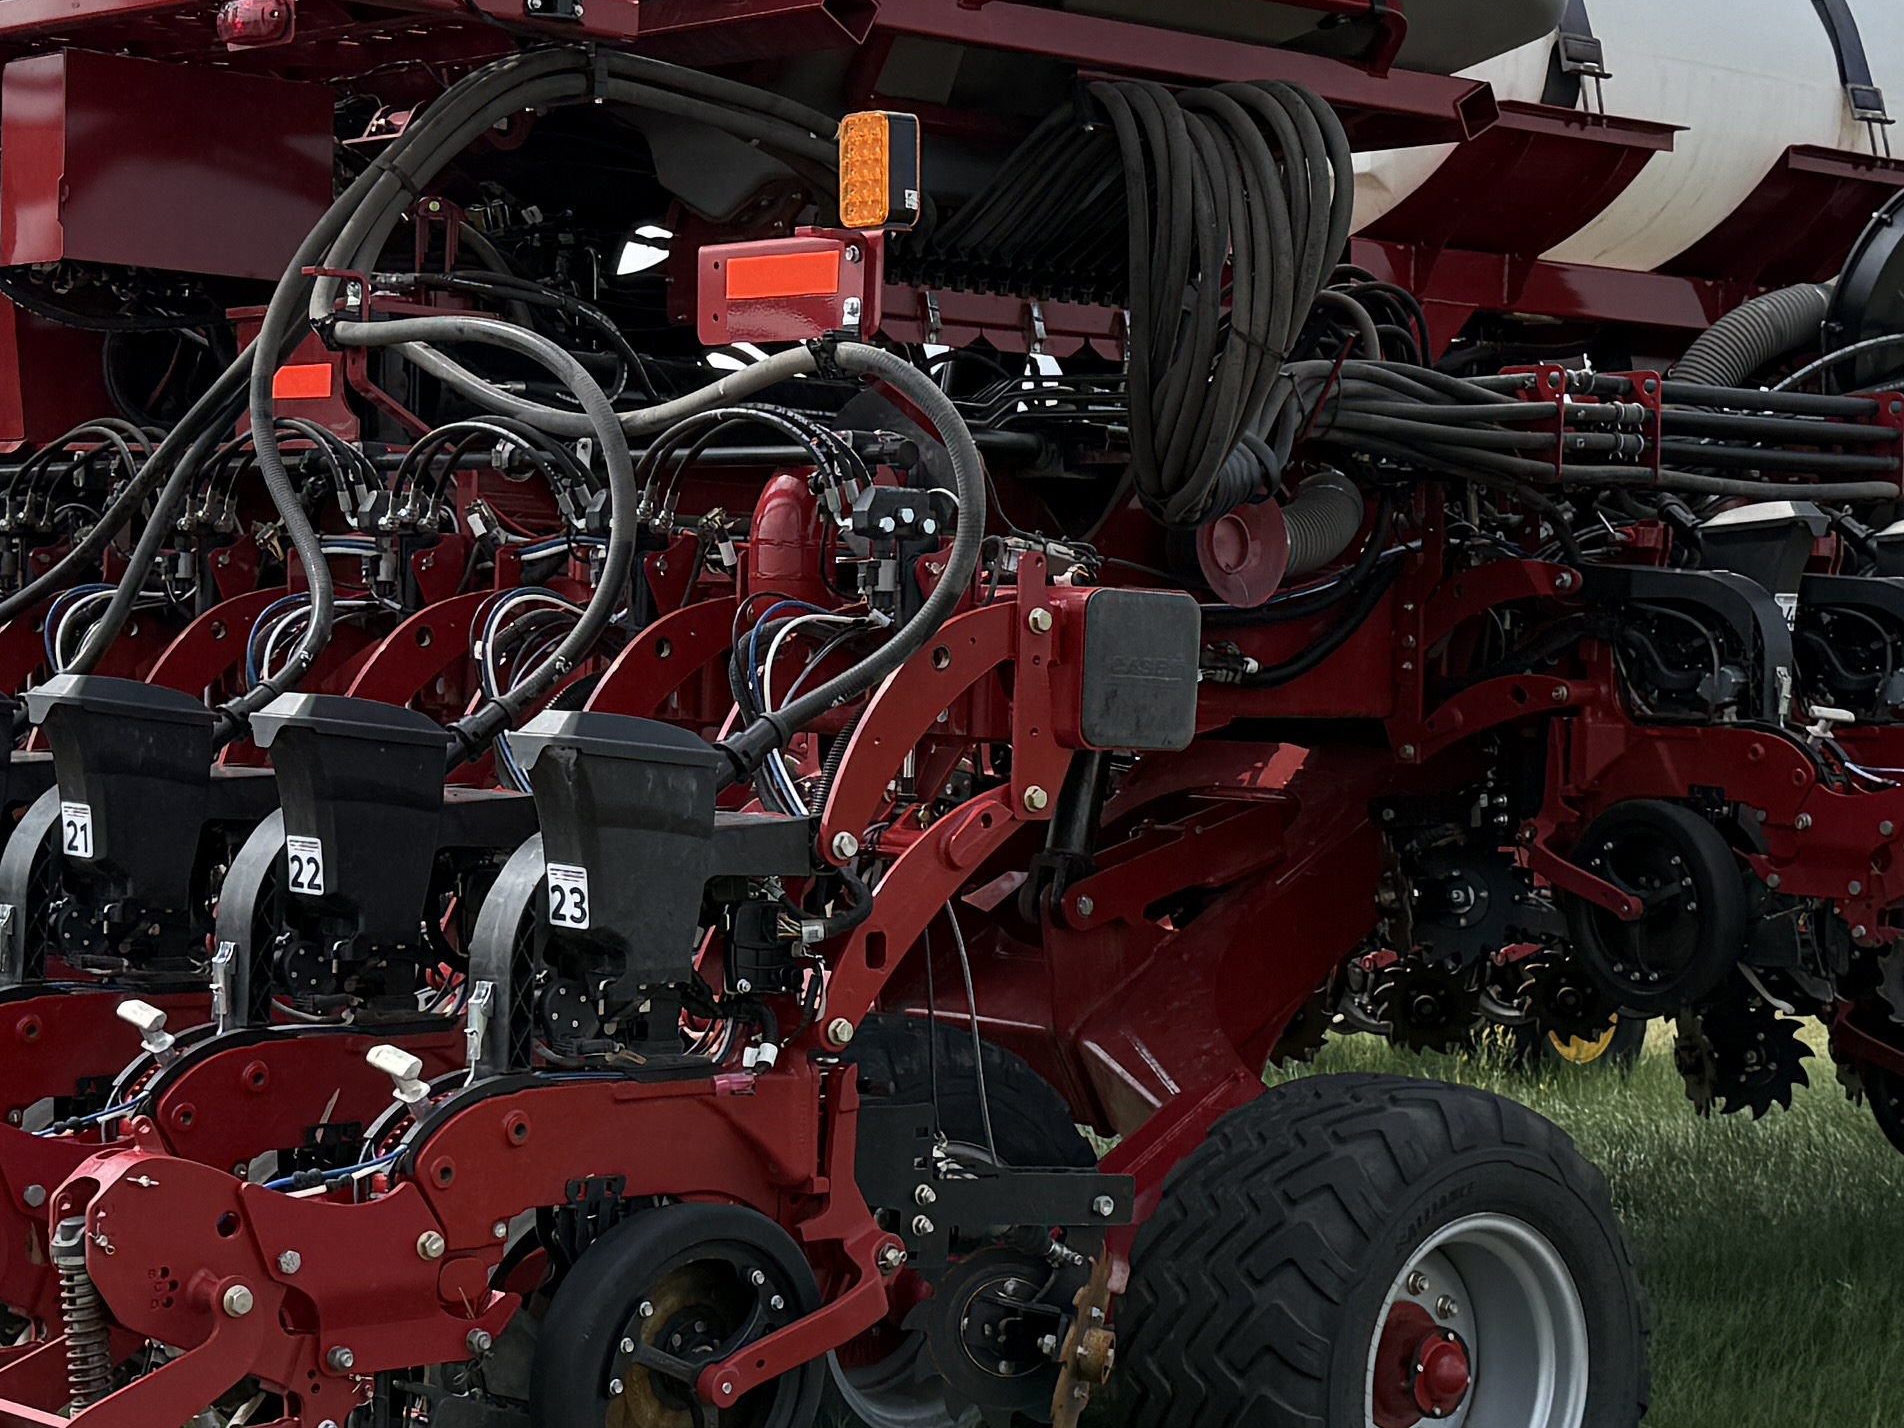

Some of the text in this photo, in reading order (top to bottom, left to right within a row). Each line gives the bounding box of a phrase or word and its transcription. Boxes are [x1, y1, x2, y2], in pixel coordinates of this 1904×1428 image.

[66, 820, 88, 853] 21
[290, 855, 322, 891] 22
[551, 884, 587, 924] 23
